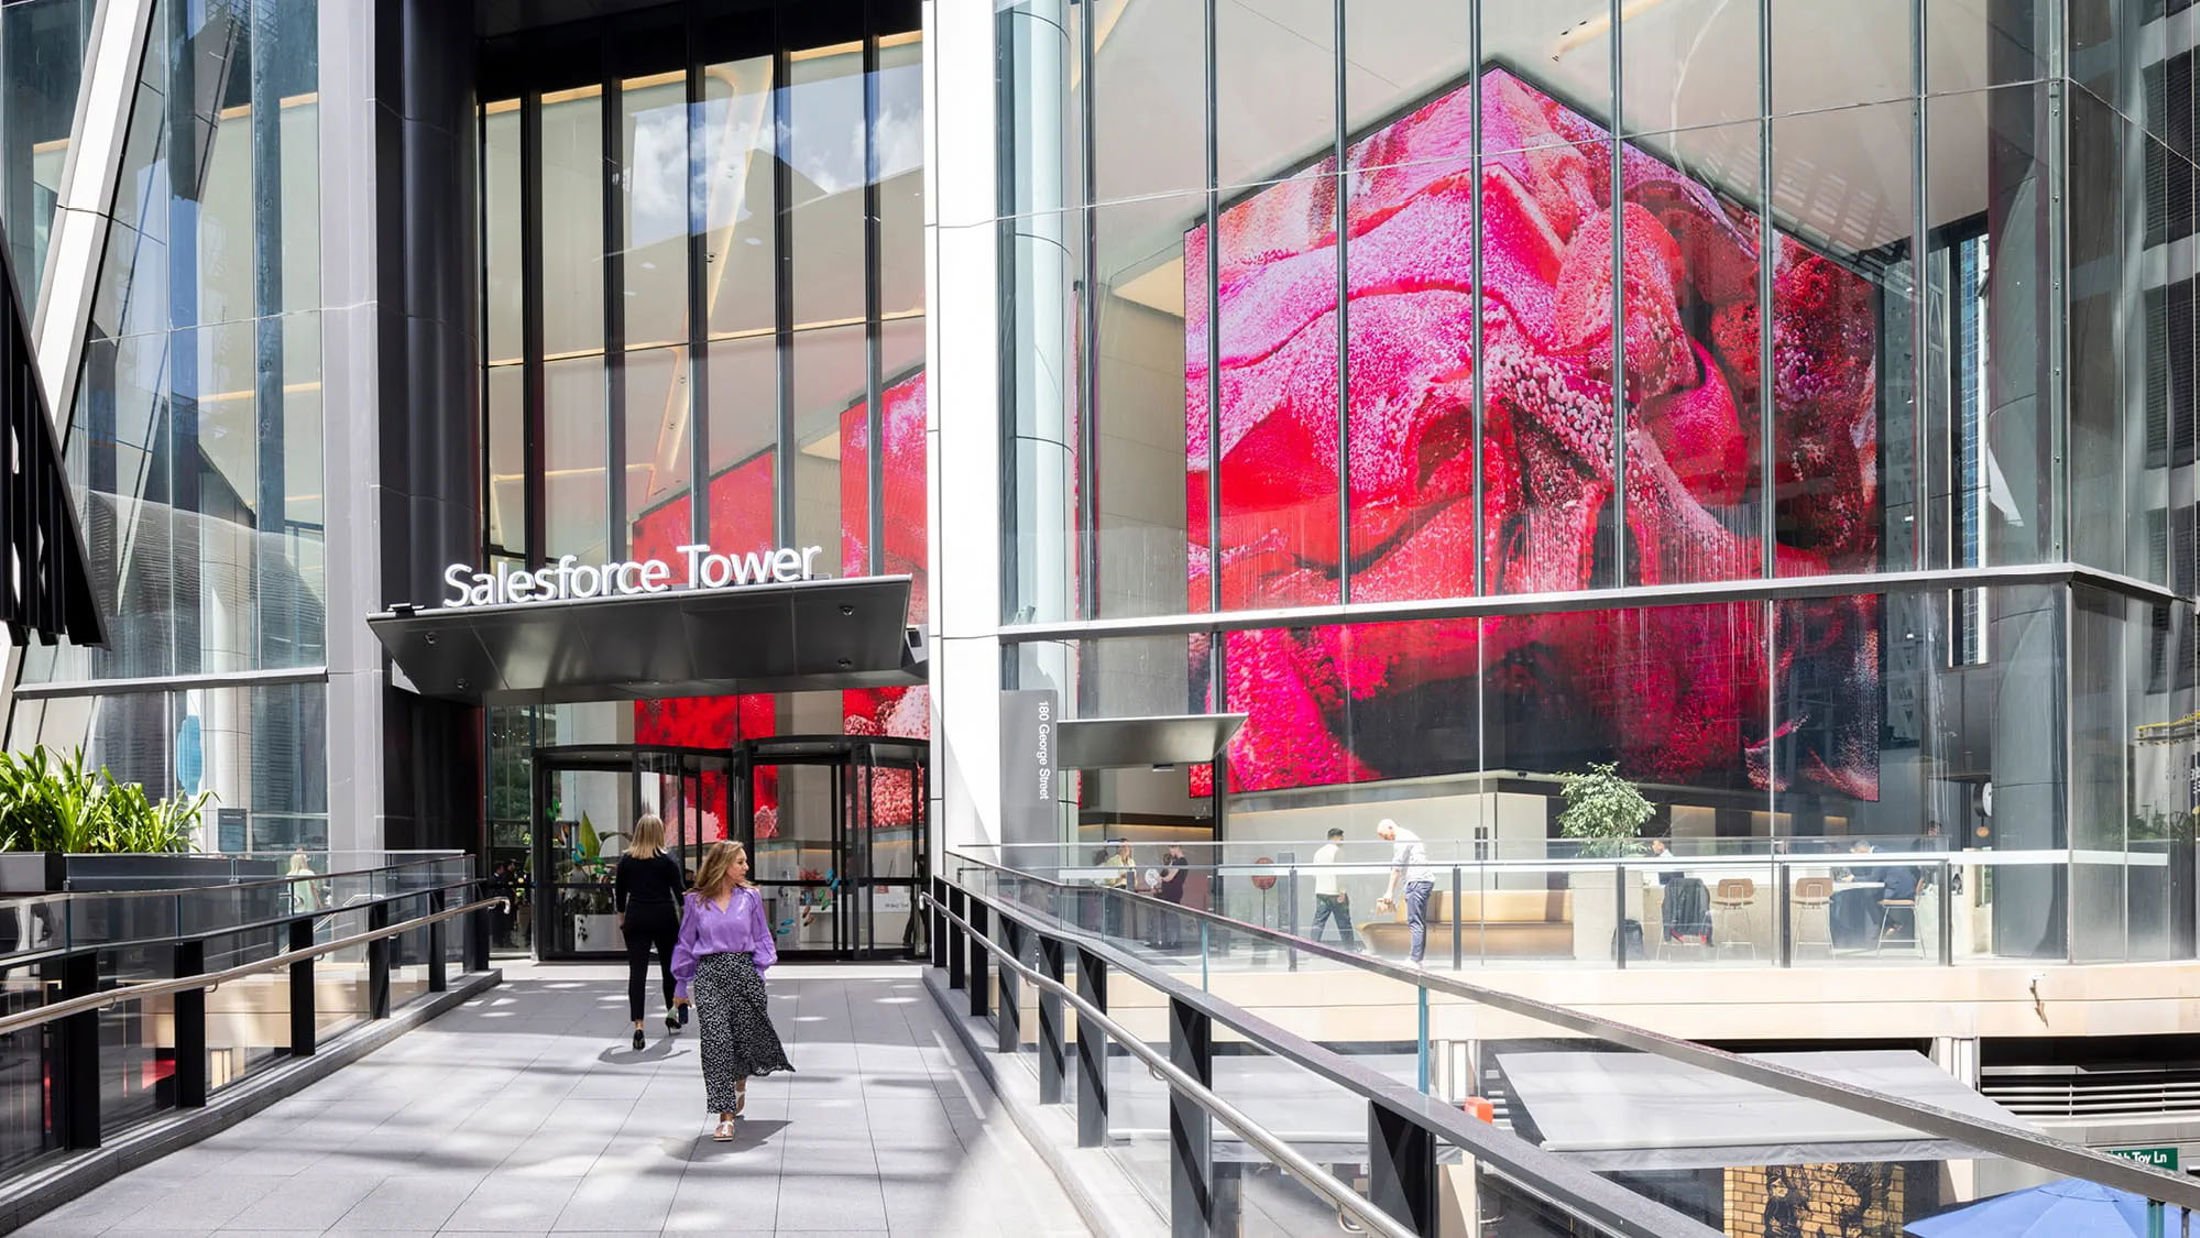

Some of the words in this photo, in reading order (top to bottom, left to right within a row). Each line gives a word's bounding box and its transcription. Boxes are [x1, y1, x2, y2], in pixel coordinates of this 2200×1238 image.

[443, 554, 671, 608] Salesforce
[676, 543, 823, 589] Tower
[1038, 701, 1050, 721] 180
[1036, 724, 1050, 765] George
[1039, 768, 1051, 800] Street
[2132, 1151, 2151, 1164] Toy
[2153, 1150, 2167, 1163] Ln
